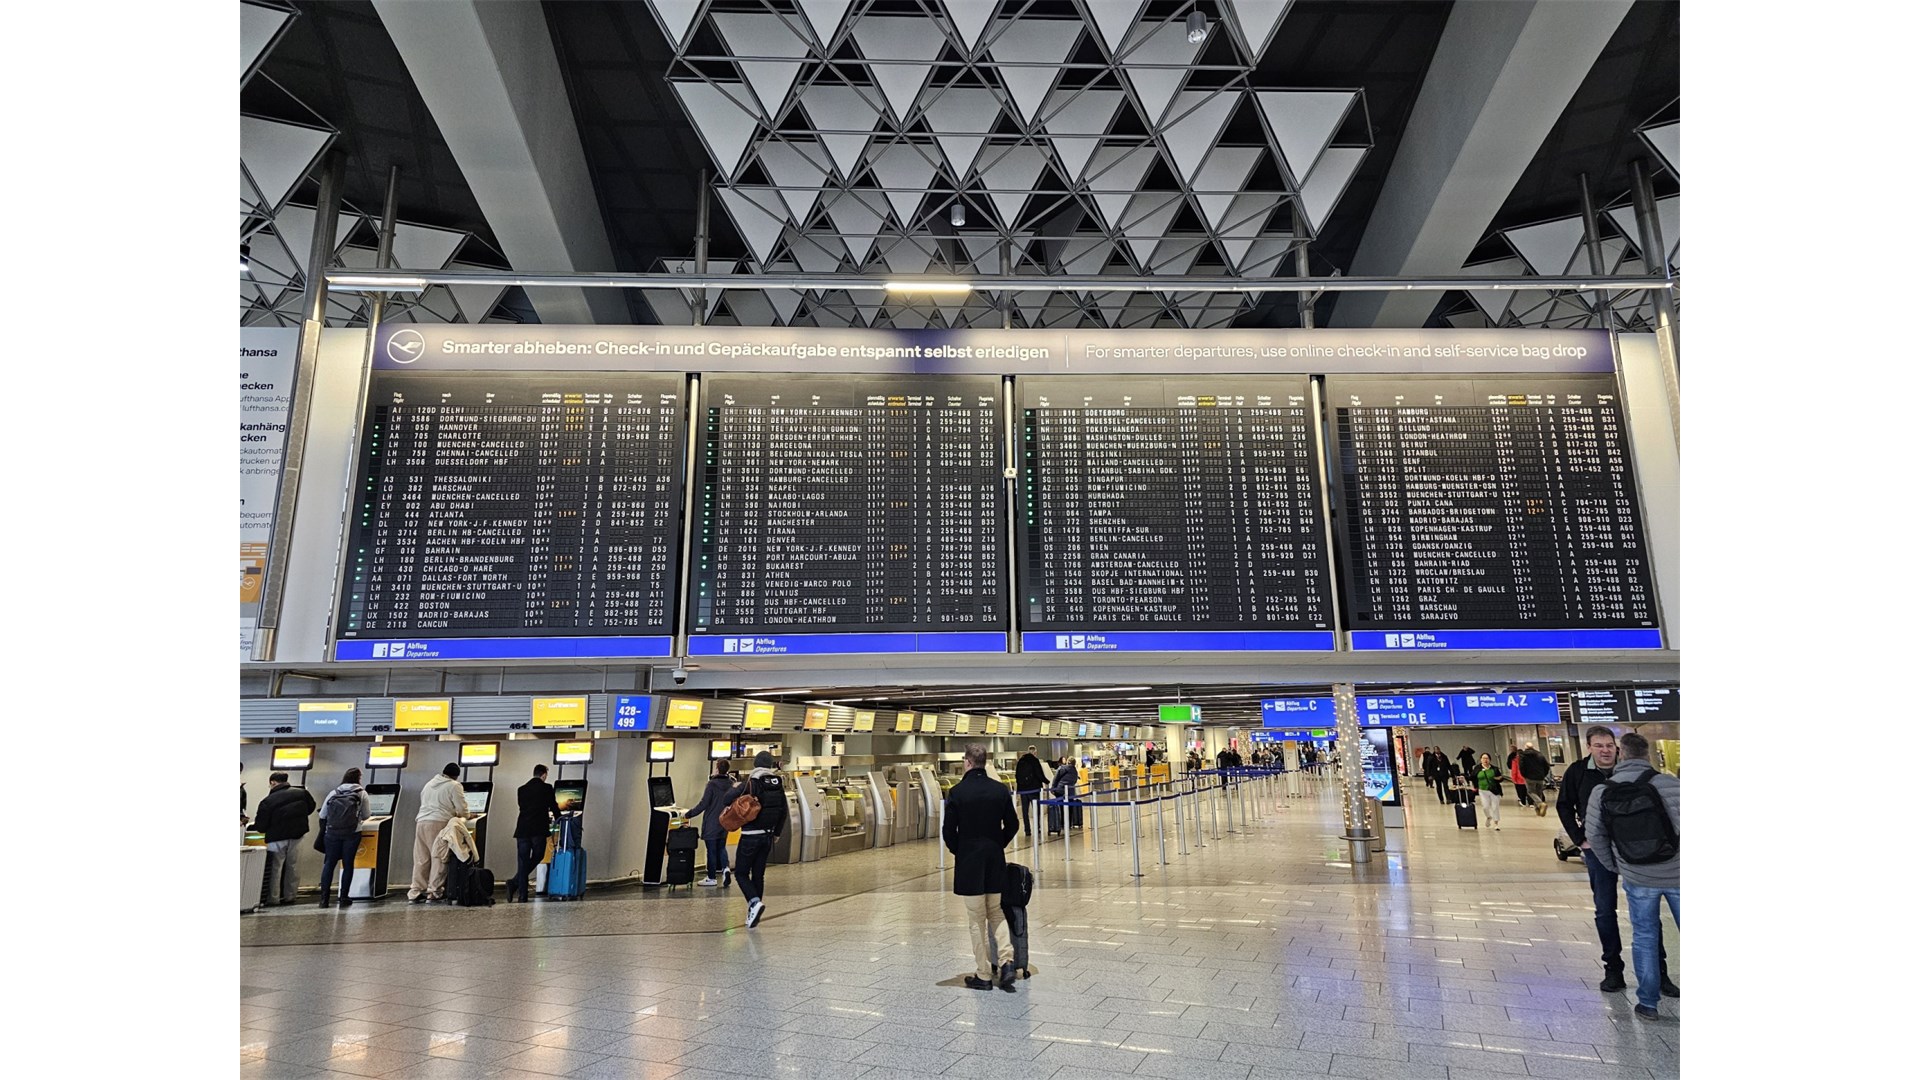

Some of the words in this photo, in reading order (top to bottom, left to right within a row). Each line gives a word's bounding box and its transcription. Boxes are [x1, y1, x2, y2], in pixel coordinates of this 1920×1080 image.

[443, 340, 511, 355] Smarter
[513, 341, 592, 356] abheben:
[595, 342, 670, 356] Check-in
[673, 343, 705, 356] und
[708, 342, 837, 358] Gepäckaufgabe
[840, 346, 921, 359] entspannt
[924, 345, 972, 358] selbst
[975, 345, 1049, 360] erledigen
[1086, 345, 1109, 358] For
[1113, 346, 1170, 358] smarter
[1173, 345, 1257, 360] departures,
[1261, 348, 1287, 357] use
[1290, 344, 1334, 357] online
[1337, 344, 1400, 357] check-in
[1403, 344, 1431, 357] and
[1434, 344, 1518, 357] self-service
[1521, 344, 1549, 359] bag
[1552, 345, 1587, 358] drop
[755, 645, 788, 653] Departures
[1086, 641, 1118, 650] Departures
[1416, 641, 1448, 649] Departures
[406, 650, 440, 658] Departures
[1309, 700, 1318, 711] C
[1406, 698, 1416, 709] B
[1506, 695, 1529, 708] A,Z
[617, 718, 636, 728] 499
[1408, 713, 1428, 725] D,E
